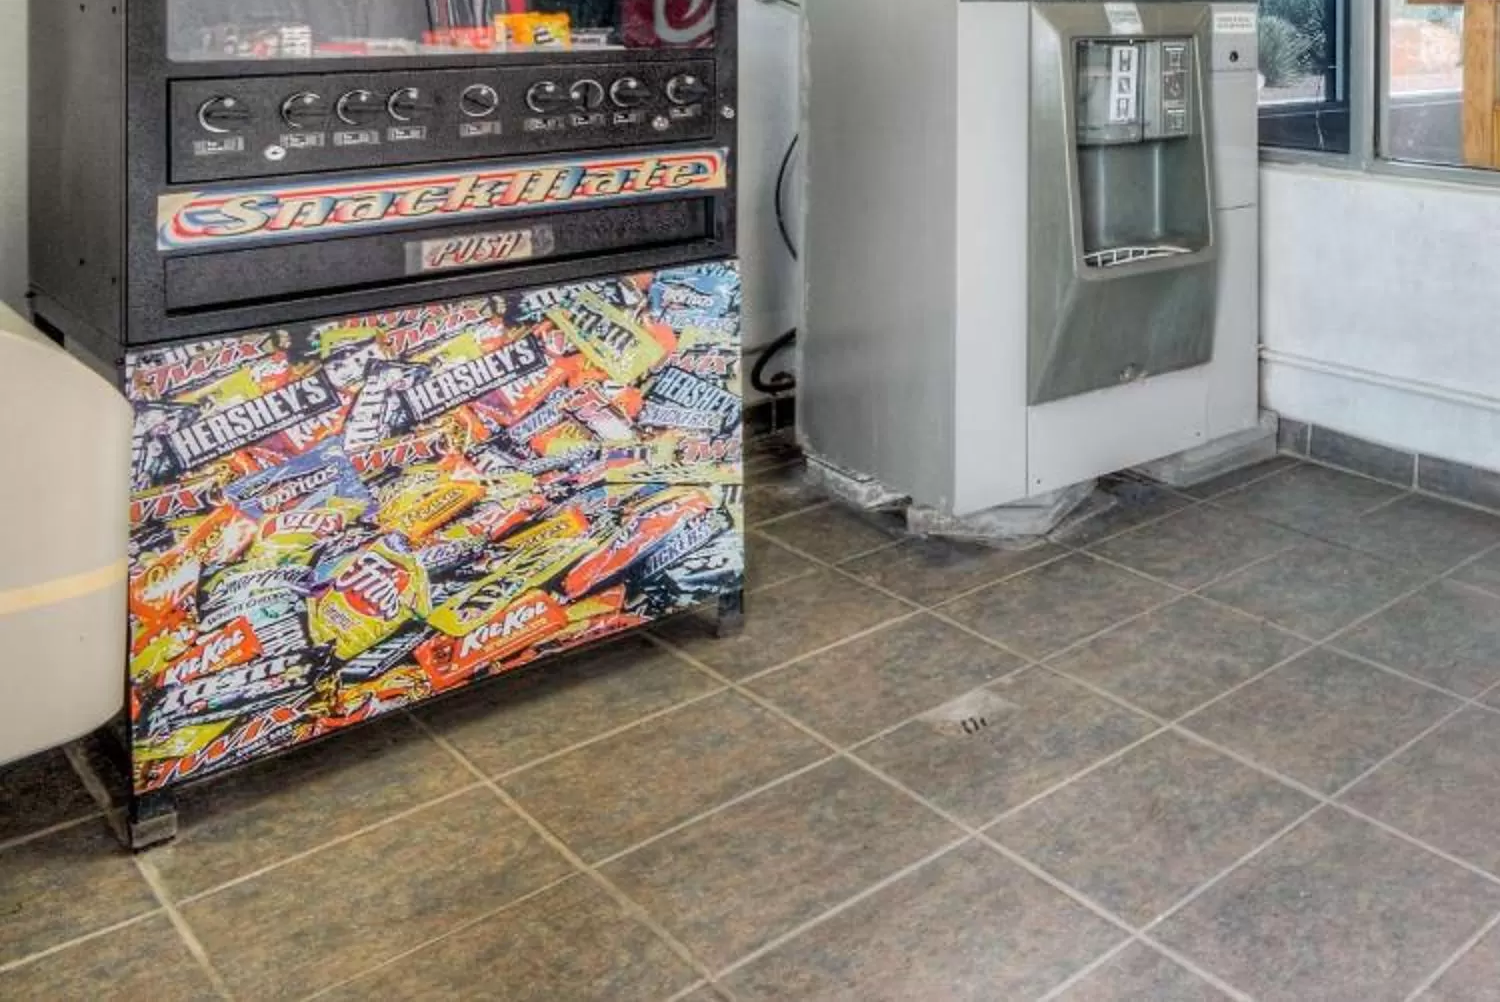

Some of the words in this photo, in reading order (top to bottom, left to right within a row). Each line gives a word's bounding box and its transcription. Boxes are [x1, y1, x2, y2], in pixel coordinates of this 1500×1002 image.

[205, 158, 703, 235] SnackMate
[431, 232, 521, 267] PUSH
[406, 338, 537, 419] HERSHEY'S
